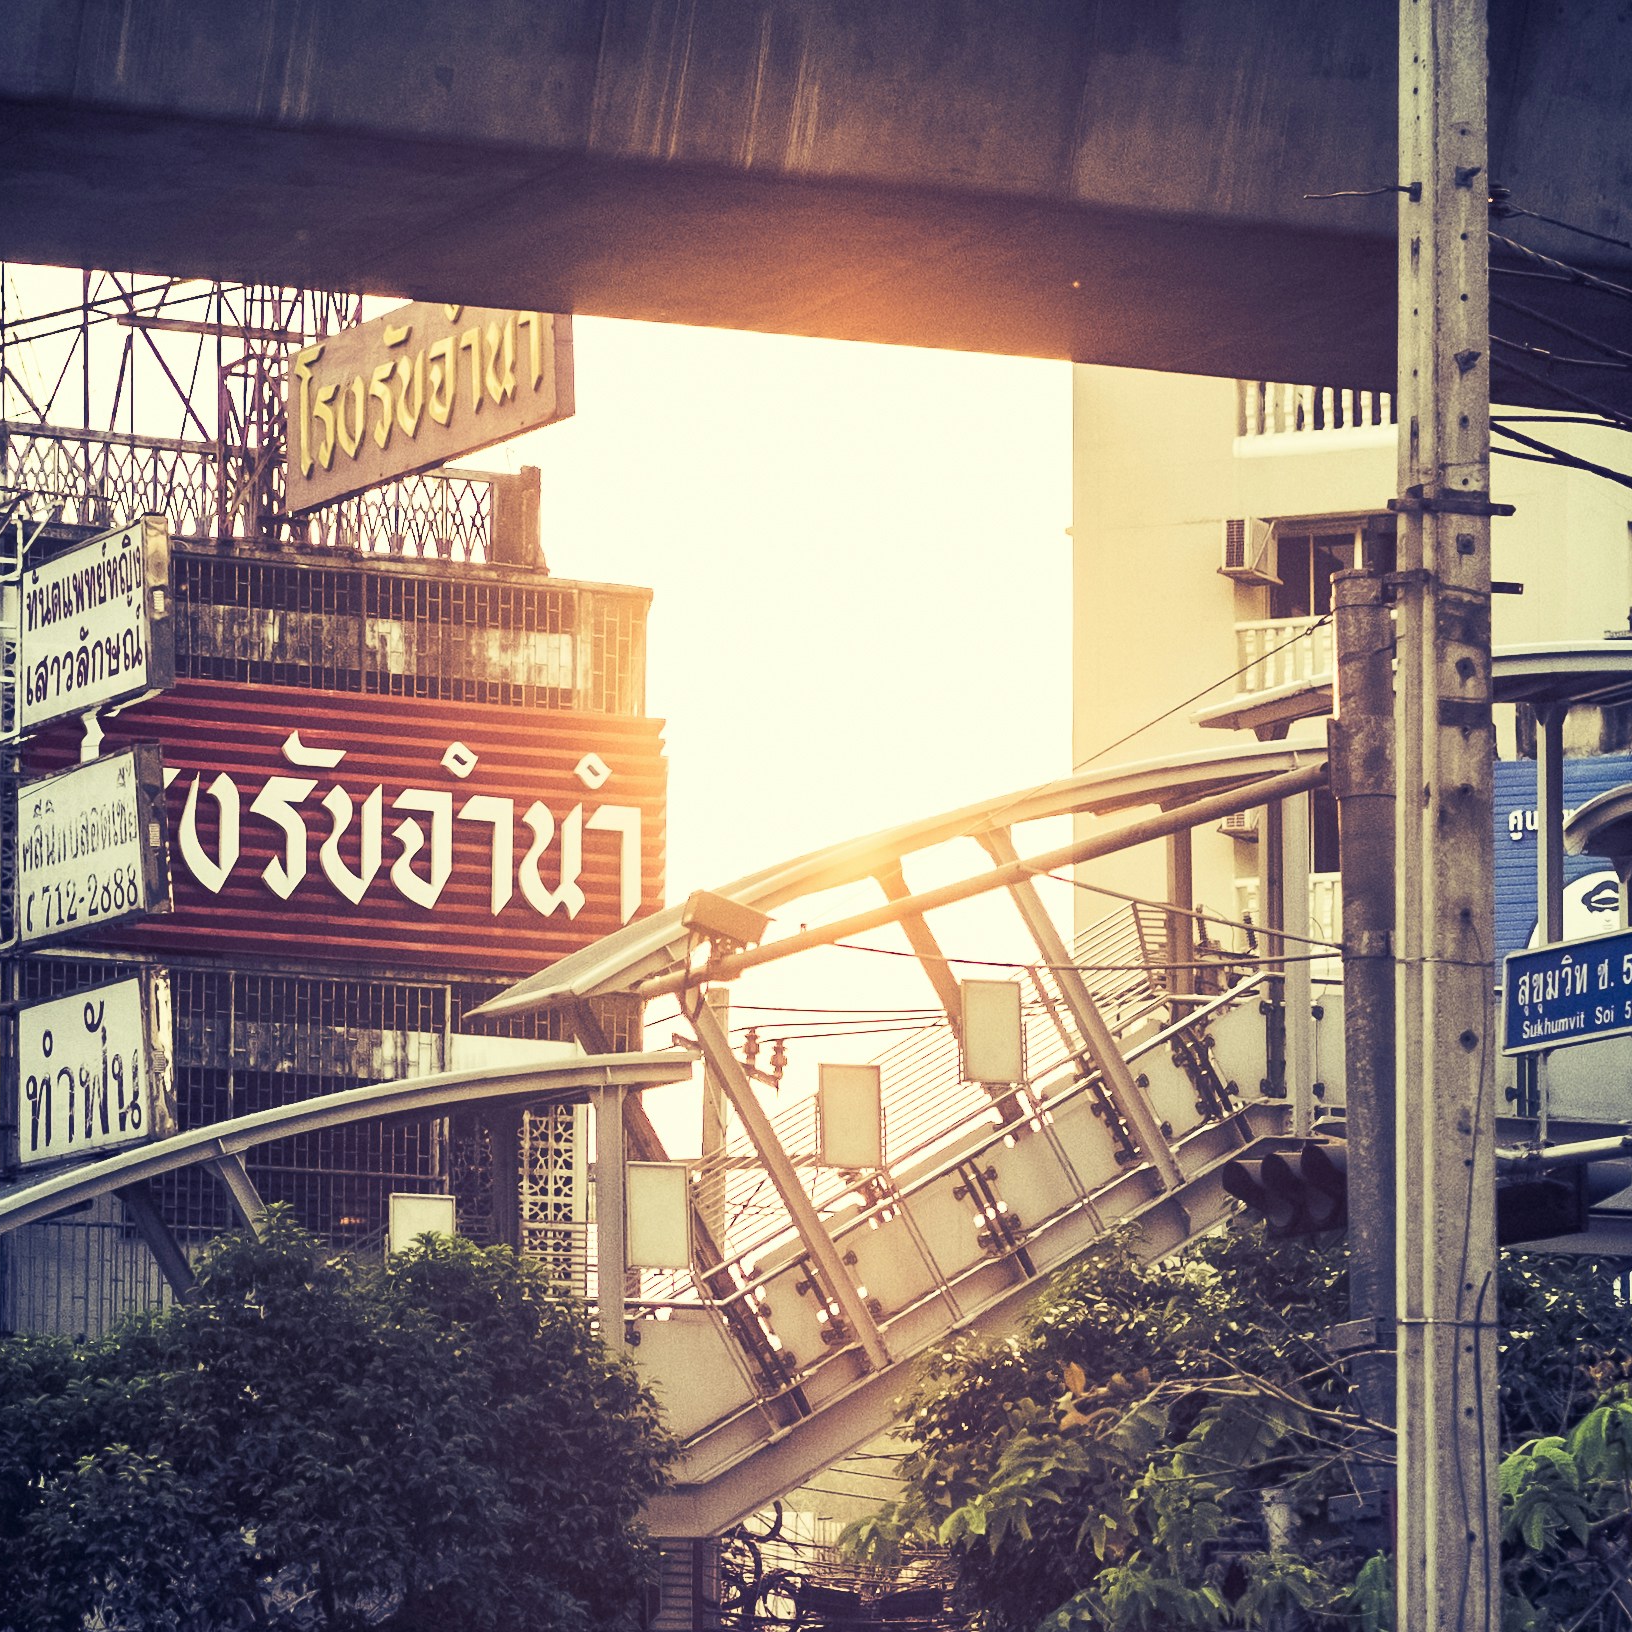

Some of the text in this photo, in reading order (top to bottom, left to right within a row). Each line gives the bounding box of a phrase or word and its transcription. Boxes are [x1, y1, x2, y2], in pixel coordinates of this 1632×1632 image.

[25, 534, 142, 632] ทันตแพทย์หญิง
[25, 603, 143, 706] เสาวลักษณ์
[1518, 954, 1588, 1016] สุขุมวิท
[1522, 1011, 1585, 1039] Sukhumvit
[1594, 1005, 1615, 1025] Soi
[25, 999, 143, 1152] ทำฟัน
